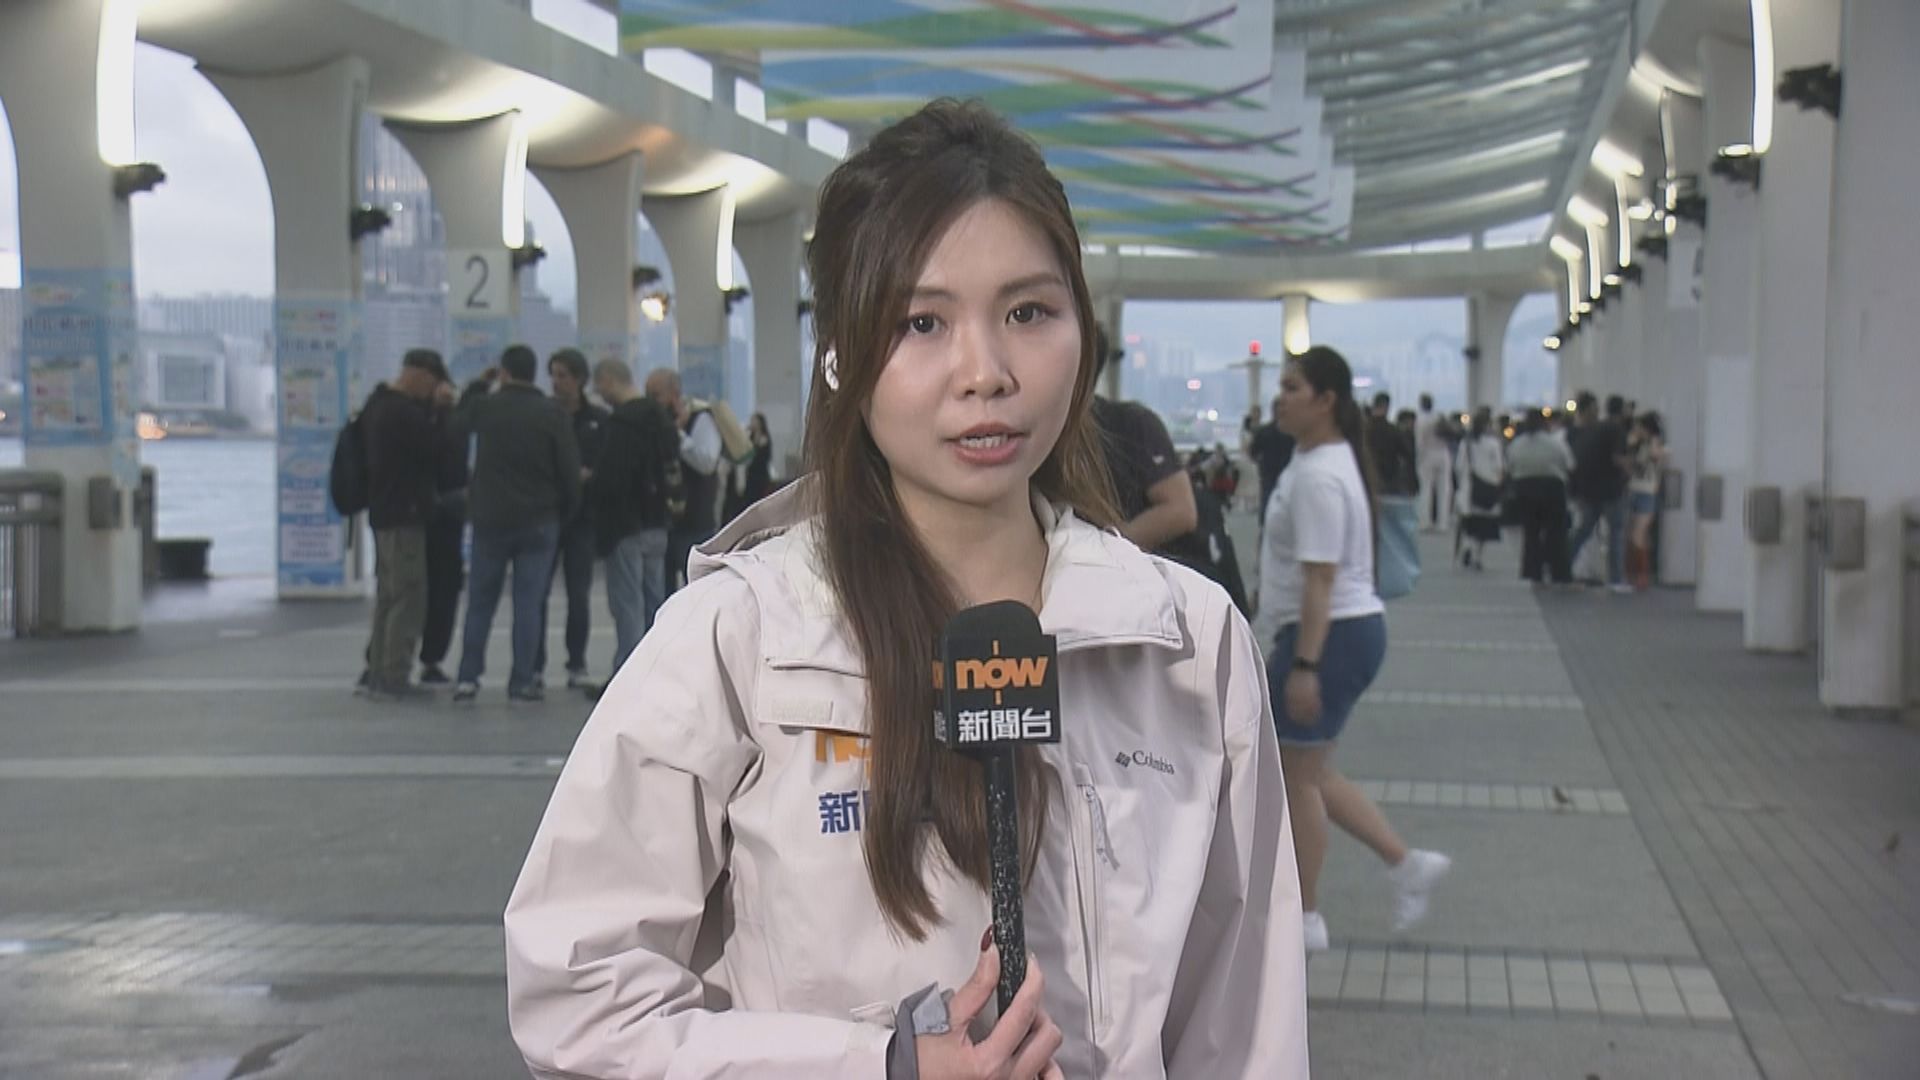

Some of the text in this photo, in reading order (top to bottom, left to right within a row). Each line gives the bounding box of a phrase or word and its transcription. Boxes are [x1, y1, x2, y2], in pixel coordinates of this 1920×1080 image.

[465, 254, 490, 309] 2
[955, 656, 1049, 690] now
[958, 707, 1052, 742] 新聞台
[818, 790, 872, 833] 新
